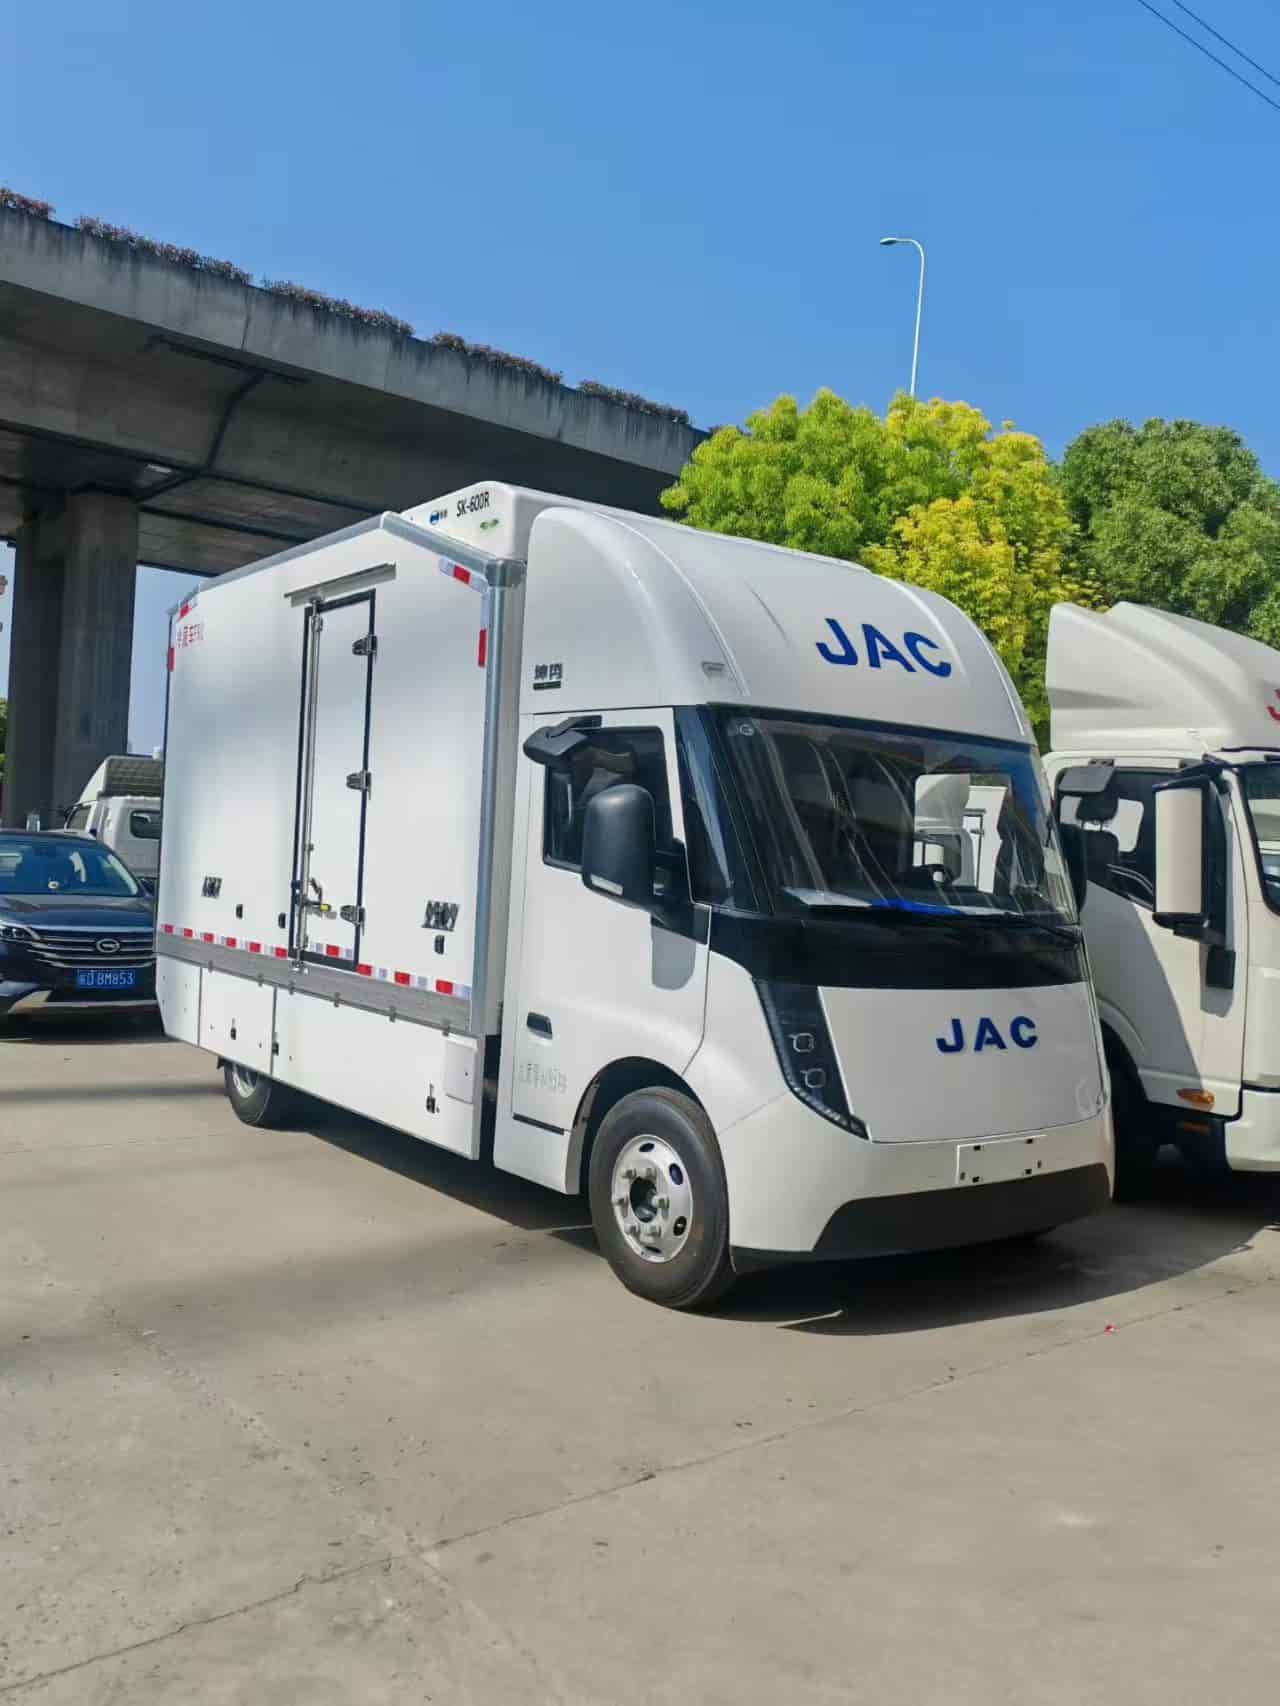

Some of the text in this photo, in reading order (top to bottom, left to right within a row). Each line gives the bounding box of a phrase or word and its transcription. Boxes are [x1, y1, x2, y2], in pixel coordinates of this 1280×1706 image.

[456, 491, 490, 517] SK-600R
[816, 618, 952, 678] JAC
[936, 1016, 1038, 1053] JAC
